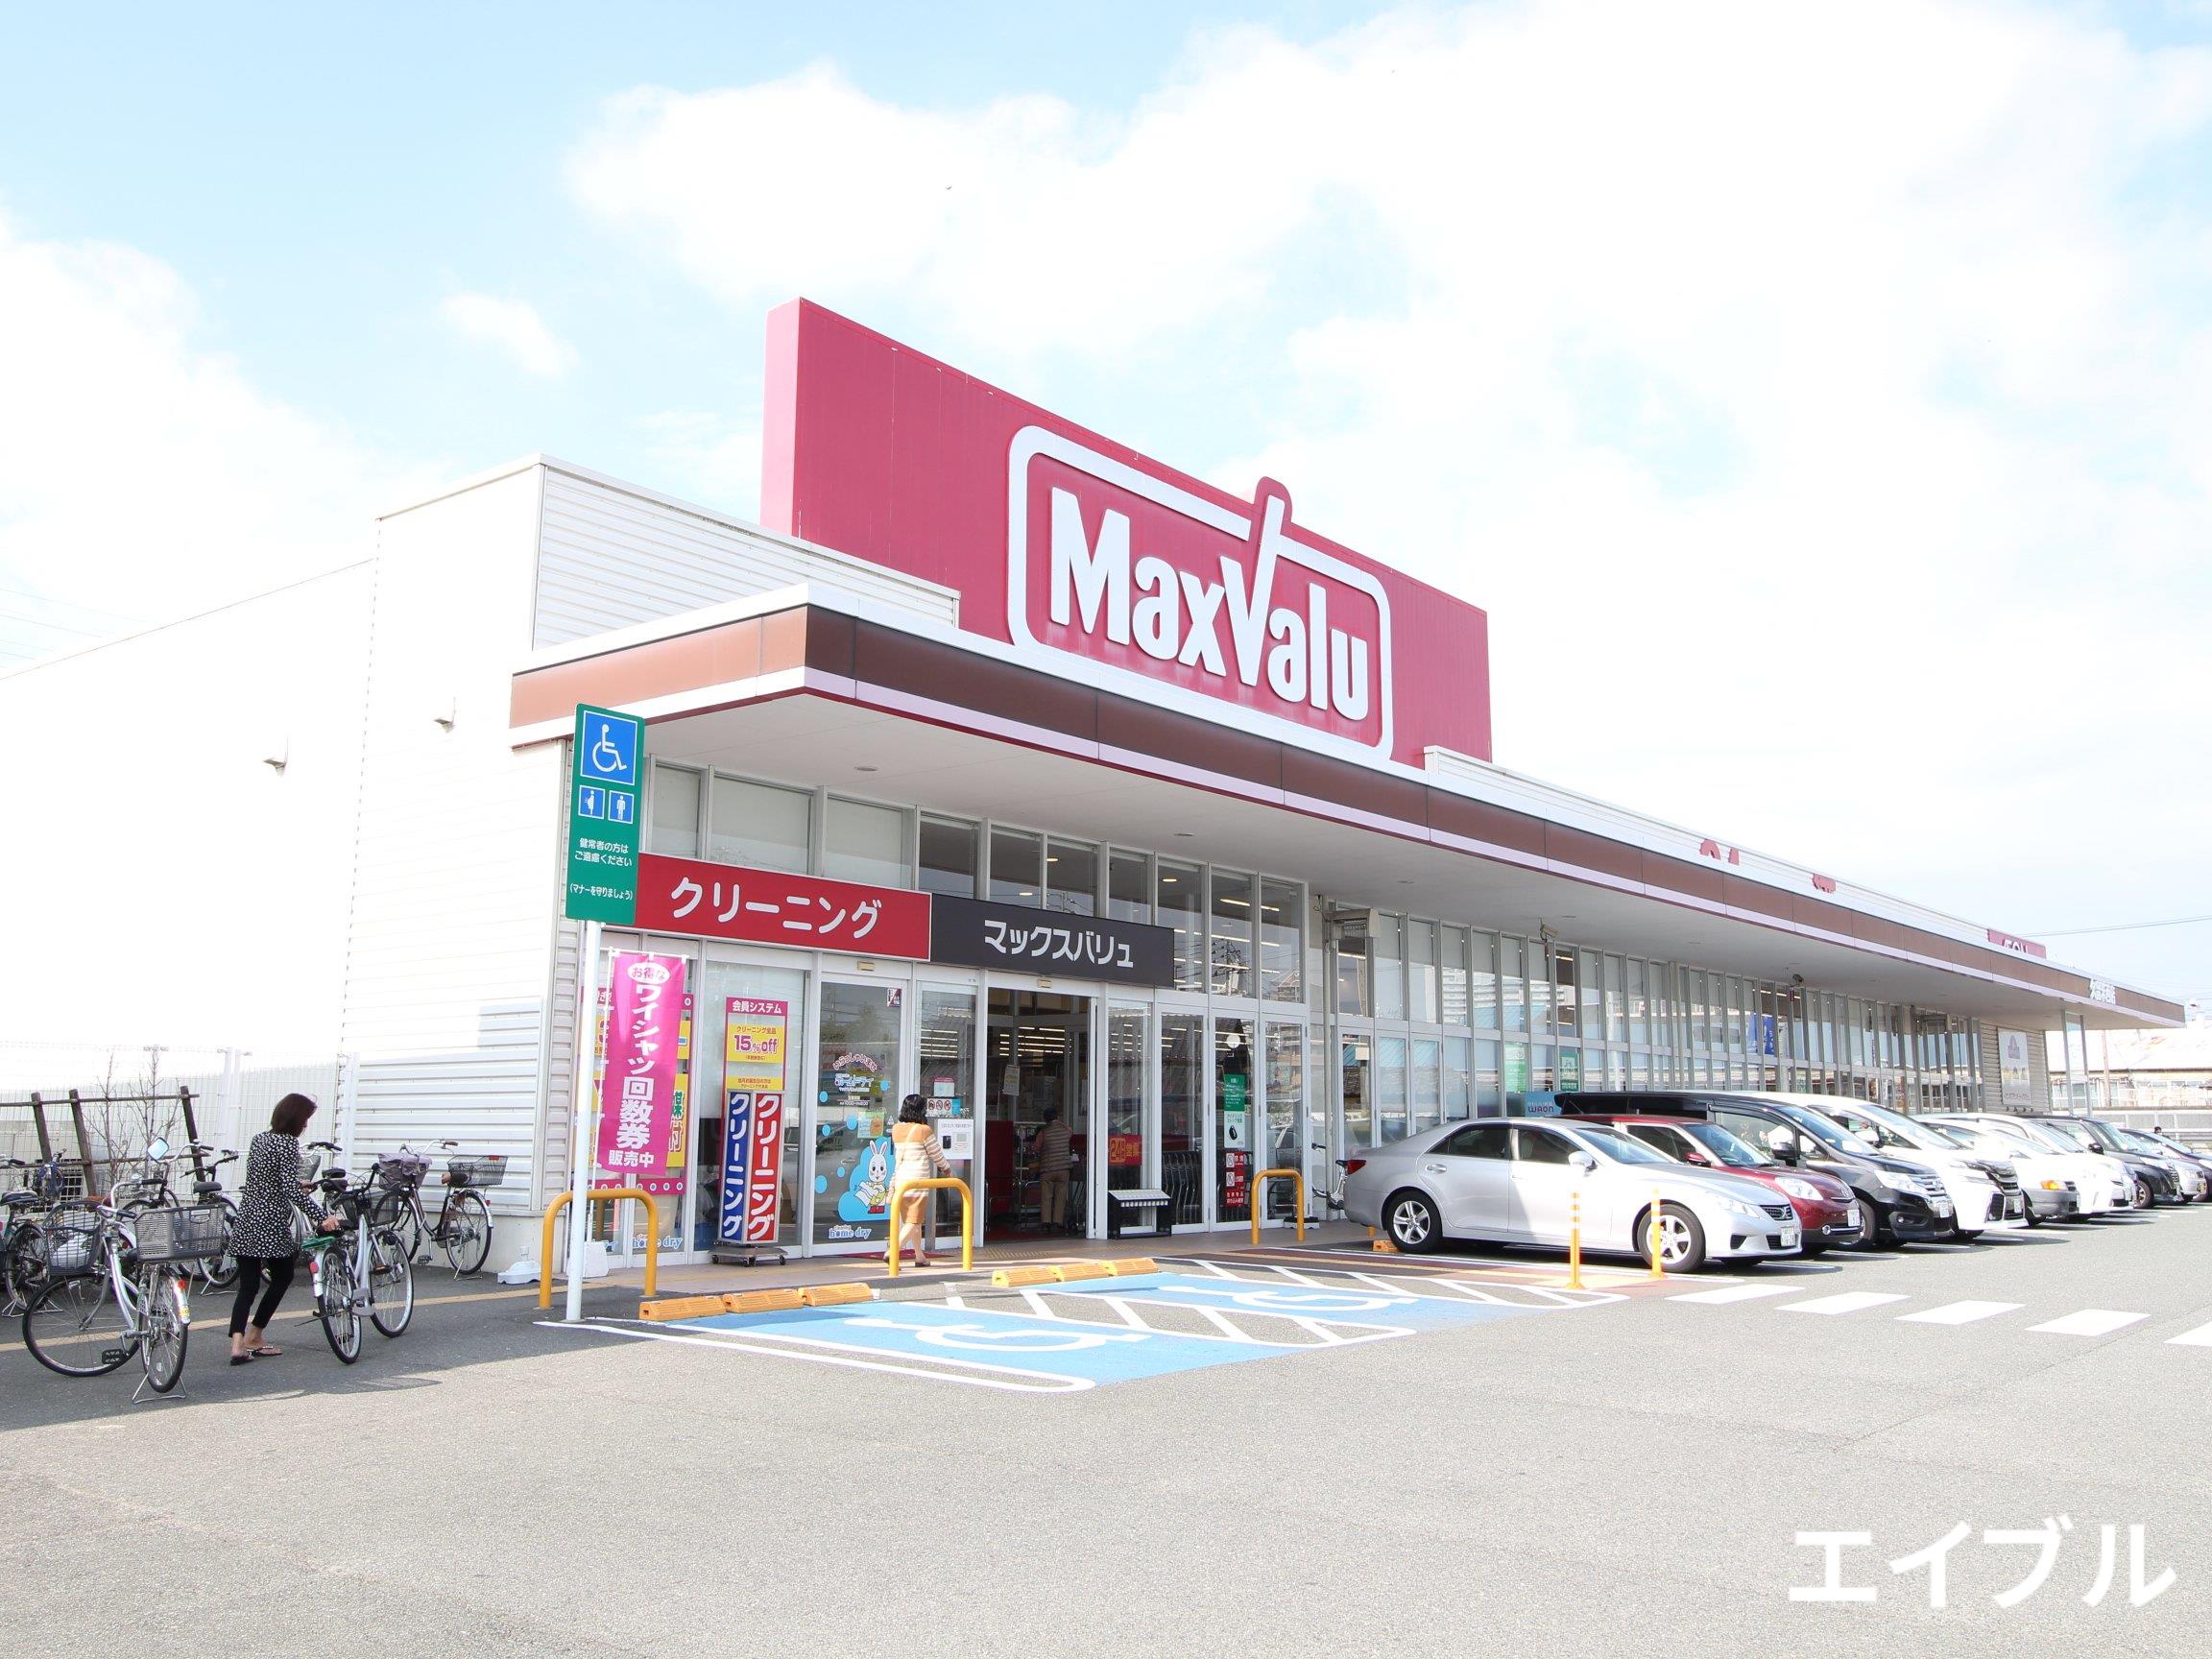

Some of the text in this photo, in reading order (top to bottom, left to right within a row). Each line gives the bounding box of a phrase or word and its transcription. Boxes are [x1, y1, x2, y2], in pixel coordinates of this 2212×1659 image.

[1050, 486, 1369, 721] MaxValu
[574, 850, 633, 867] ご遠慮ください
[579, 837, 630, 854] 健常者の方は
[671, 877, 882, 939] クリーニング
[984, 919, 1134, 969] マックスバリュ
[732, 999, 782, 1015] 会員システム
[615, 983, 662, 1150] ワイシャツ回数券
[608, 1149, 655, 1168] 販売中
[723, 1094, 750, 1238] クリーニング
[748, 1094, 780, 1240] クリーニング
[662, 1235, 684, 1250] dry
[829, 1227, 872, 1239] home dry
